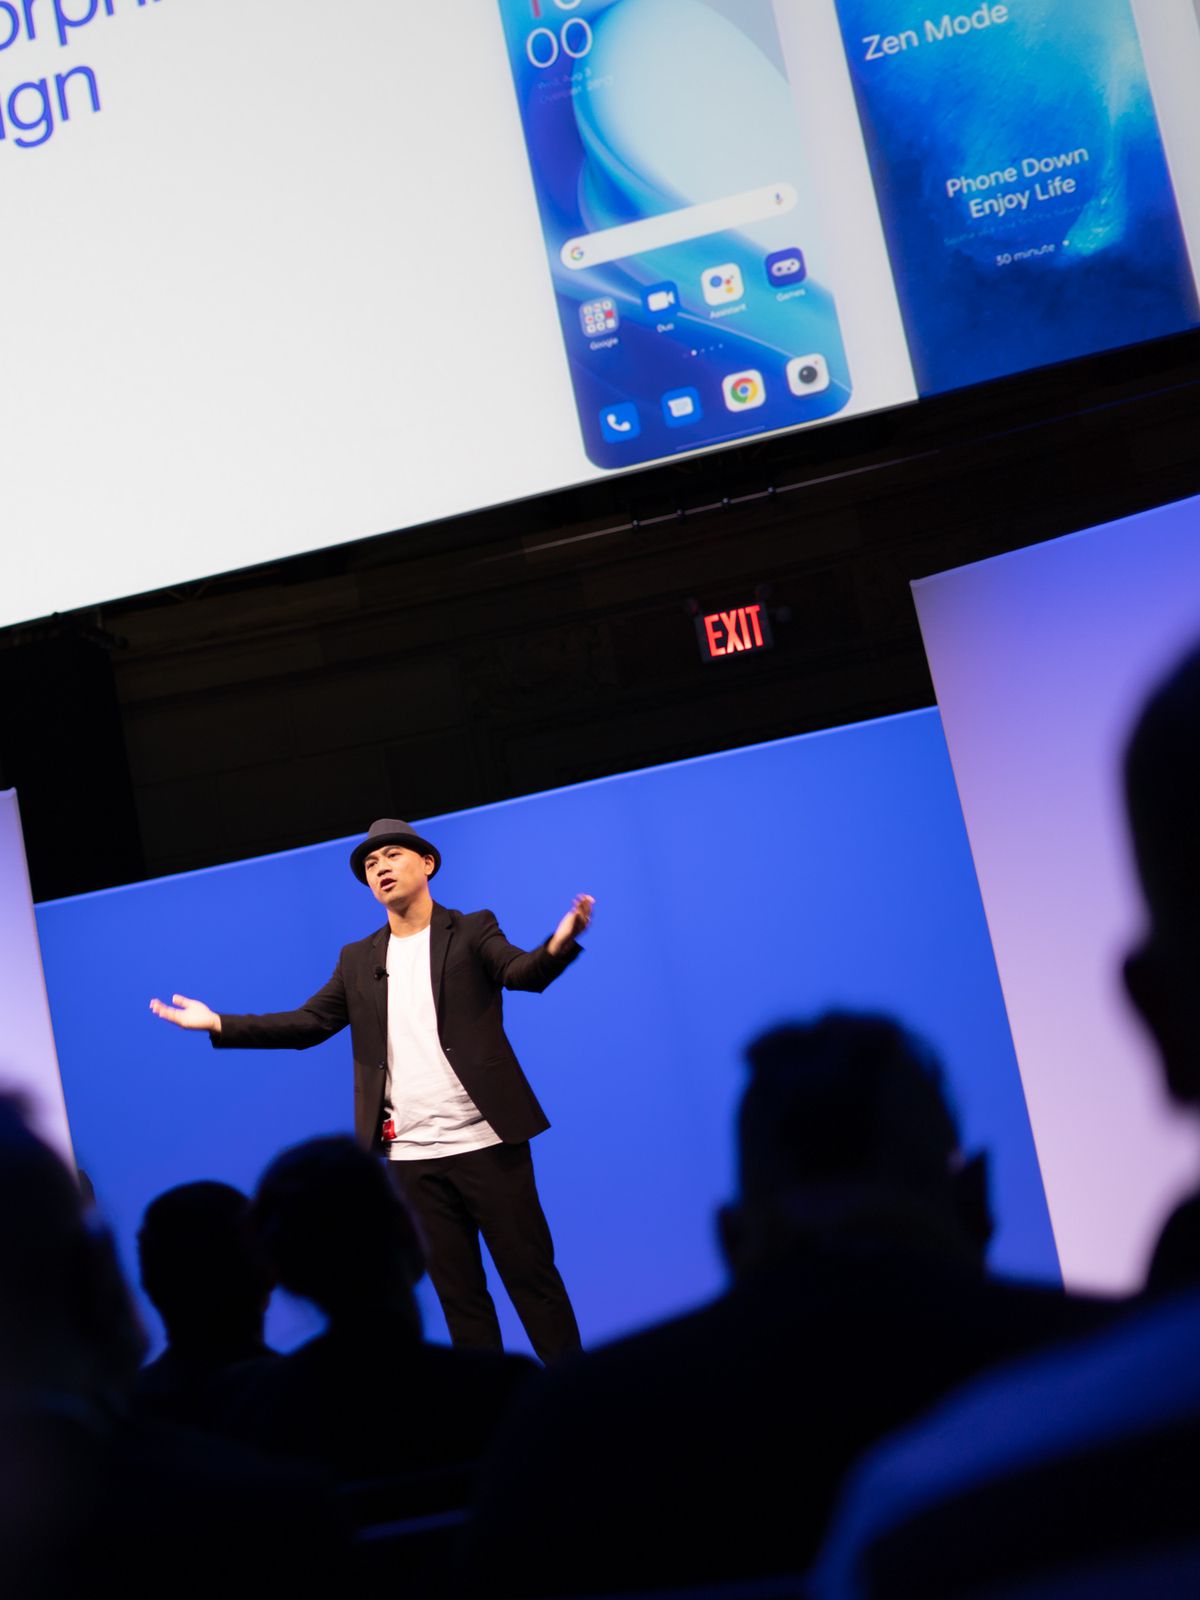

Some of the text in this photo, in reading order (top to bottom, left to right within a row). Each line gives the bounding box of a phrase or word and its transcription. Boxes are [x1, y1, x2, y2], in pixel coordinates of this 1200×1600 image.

[862, 3, 1008, 60] Zen Mode
[946, 148, 1089, 198] Phone Down
[969, 176, 1077, 218] Enjoy Life
[709, 303, 747, 319] Assistant
[776, 288, 806, 302] Games
[590, 336, 619, 351] Google
[704, 604, 764, 657] EXIT
